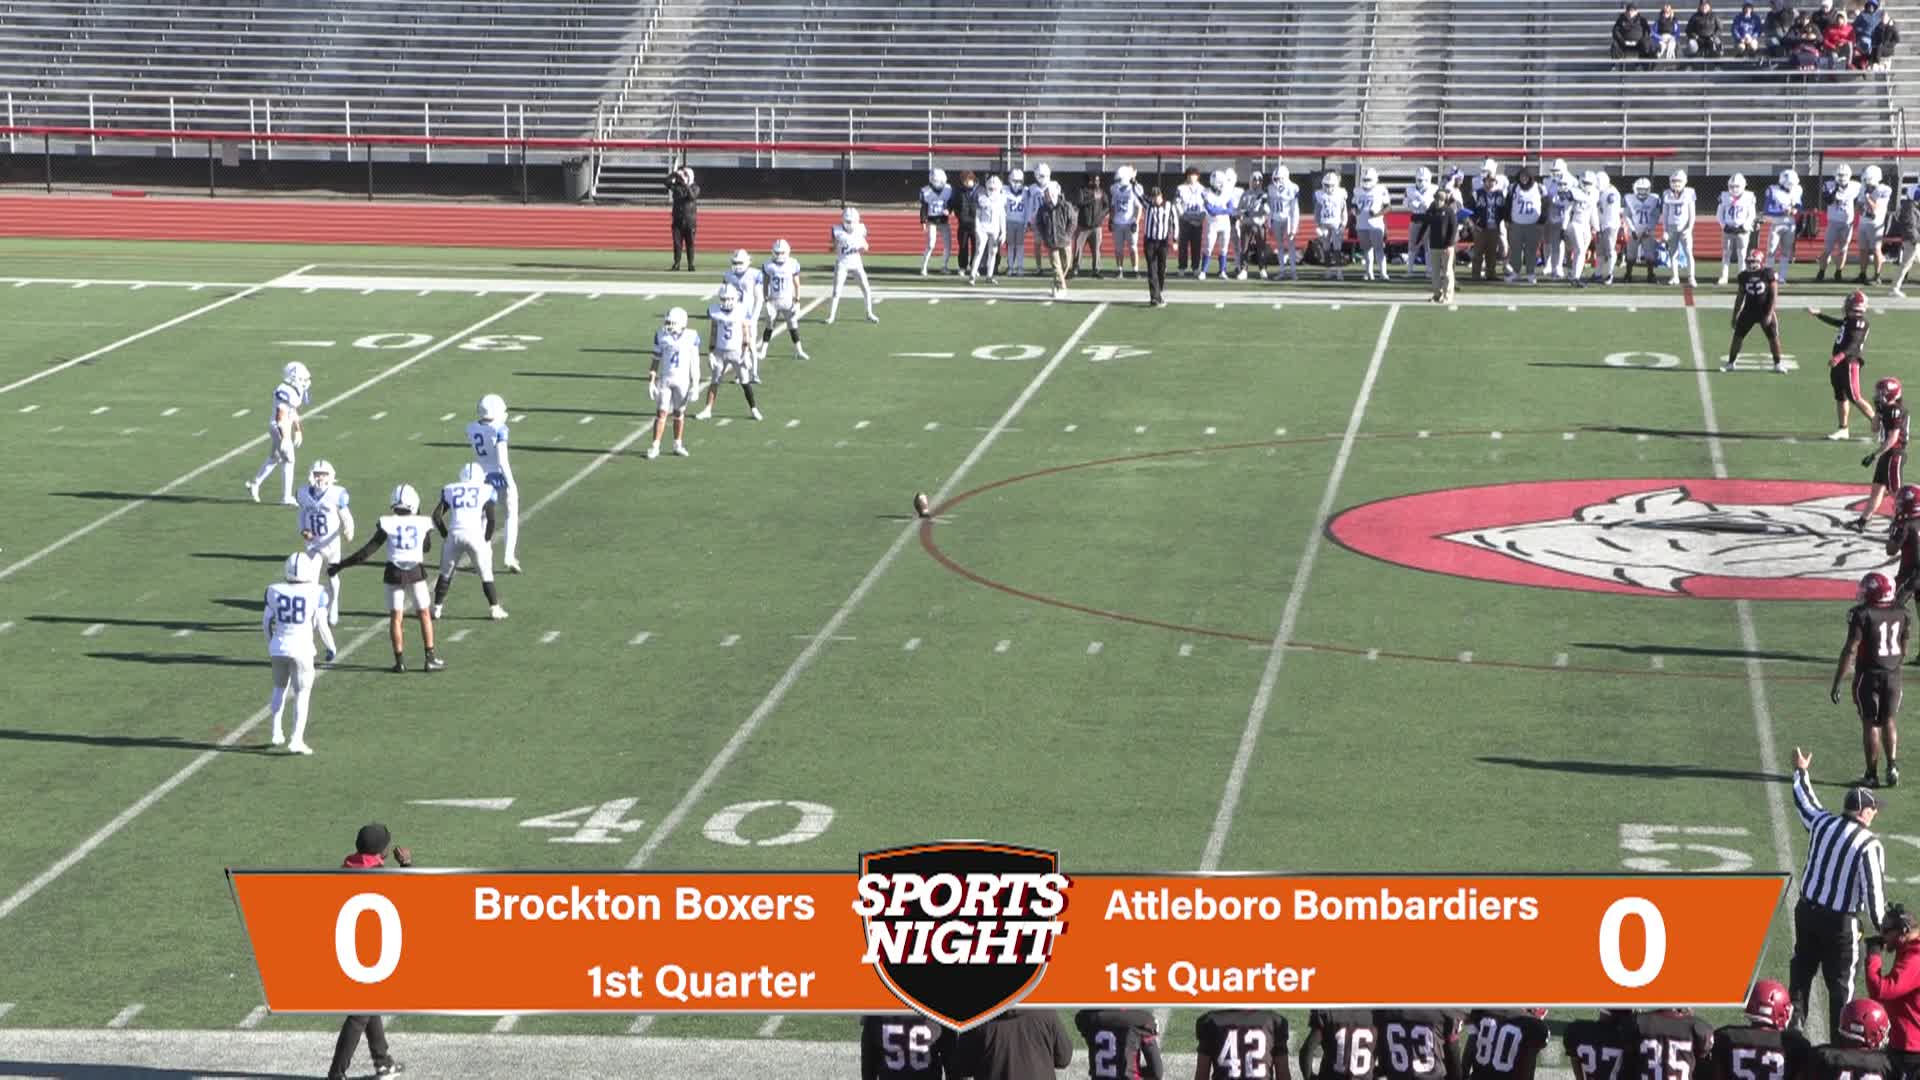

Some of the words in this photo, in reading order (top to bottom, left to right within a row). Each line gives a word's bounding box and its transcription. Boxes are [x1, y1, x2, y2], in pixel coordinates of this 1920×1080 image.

[772, 276, 785, 295] 31
[723, 323, 733, 341] 5
[669, 351, 680, 368] 4
[473, 432, 487, 457] 2
[452, 486, 480, 509] 23
[308, 513, 329, 537] 18
[396, 525, 418, 551] 13
[277, 594, 307, 625] 28
[1878, 620, 1901, 657] 11
[519, 797, 836, 847] 40
[883, 1024, 931, 1071] 56
[1095, 1030, 1117, 1077] 2
[1218, 1029, 1267, 1078] 42
[1334, 1027, 1373, 1076] 16
[1386, 1023, 1435, 1073] 63
[1476, 1017, 1522, 1073] 80
[1639, 1039, 1693, 1080] 35
